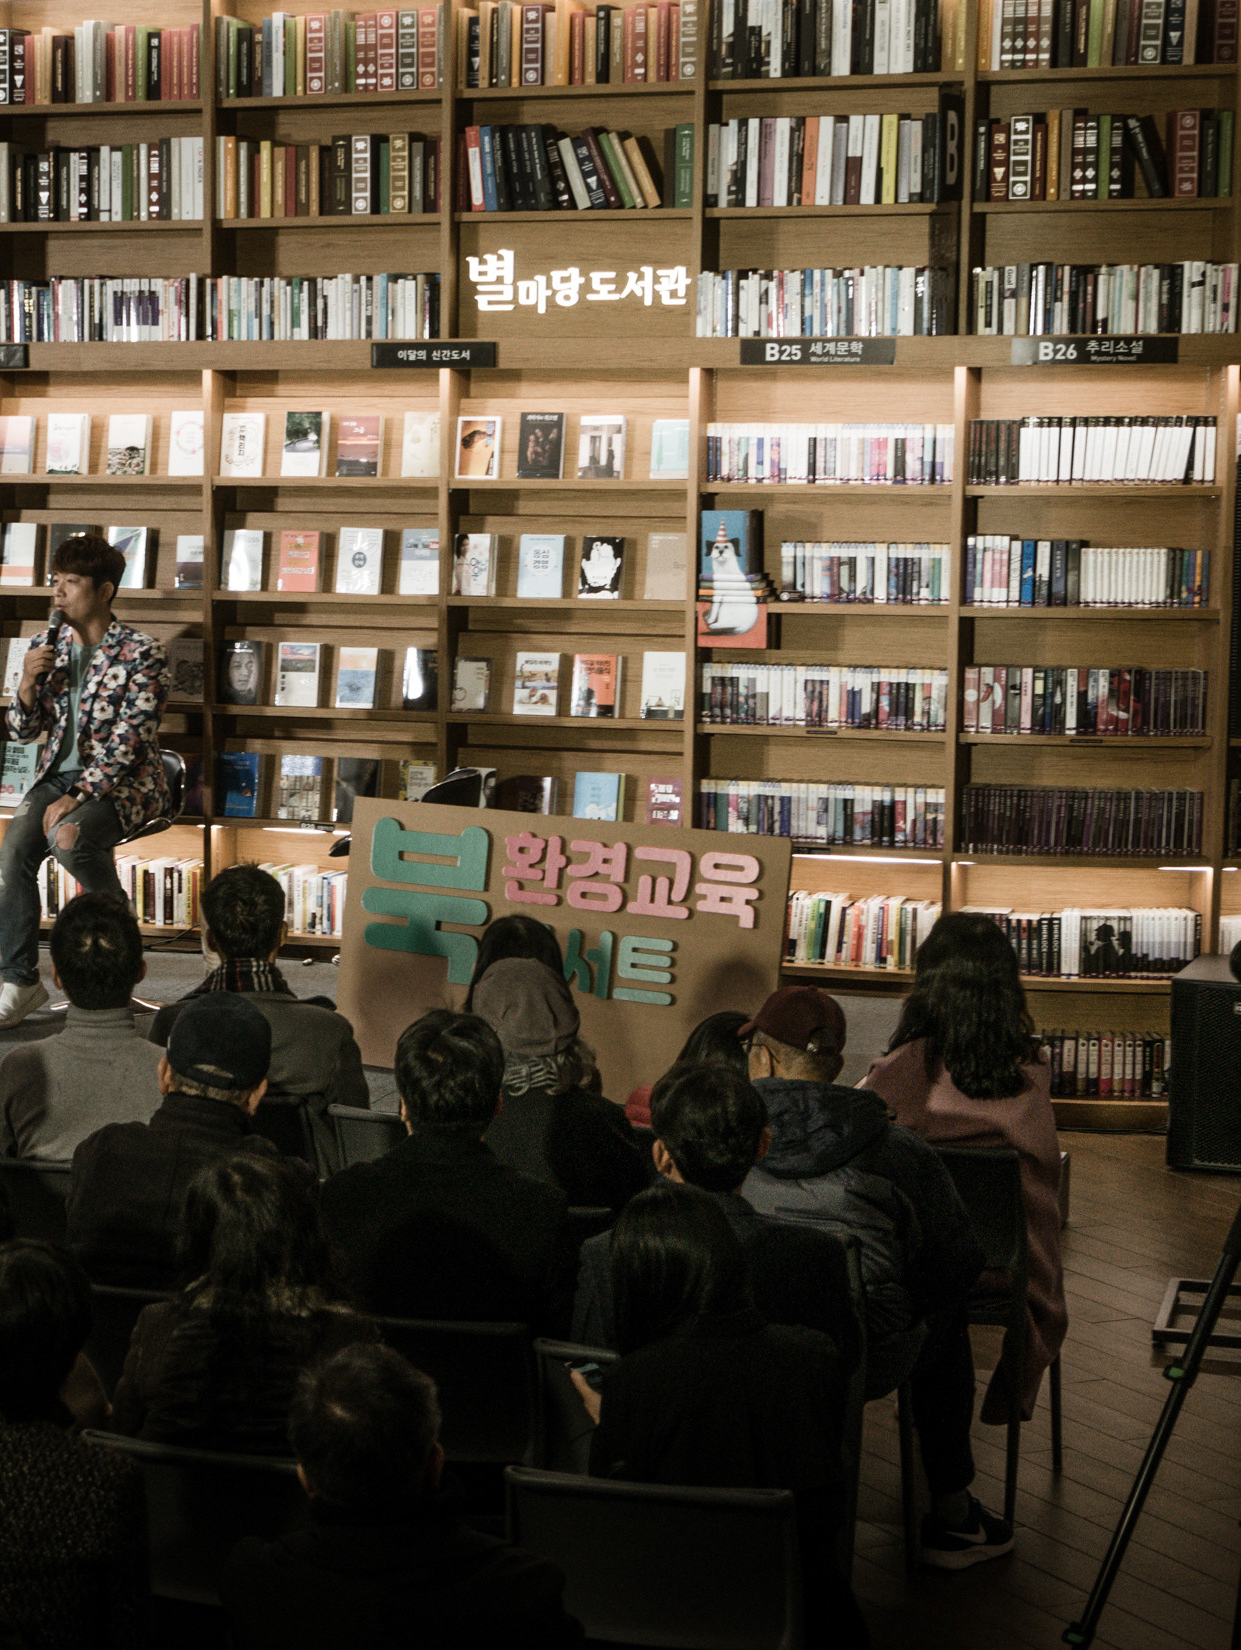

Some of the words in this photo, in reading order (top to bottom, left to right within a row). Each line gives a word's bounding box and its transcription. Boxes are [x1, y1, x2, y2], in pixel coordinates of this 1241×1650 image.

[397, 349, 427, 360] 이달의
[431, 349, 471, 360] 신간도서
[765, 342, 802, 362] B25
[809, 341, 864, 355] 세계문학
[1038, 341, 1078, 361] B26
[1086, 340, 1144, 354] 추리소설
[361, 817, 490, 985] 북
[501, 831, 760, 929] 환경교육
[548, 925, 674, 1006] 서트
